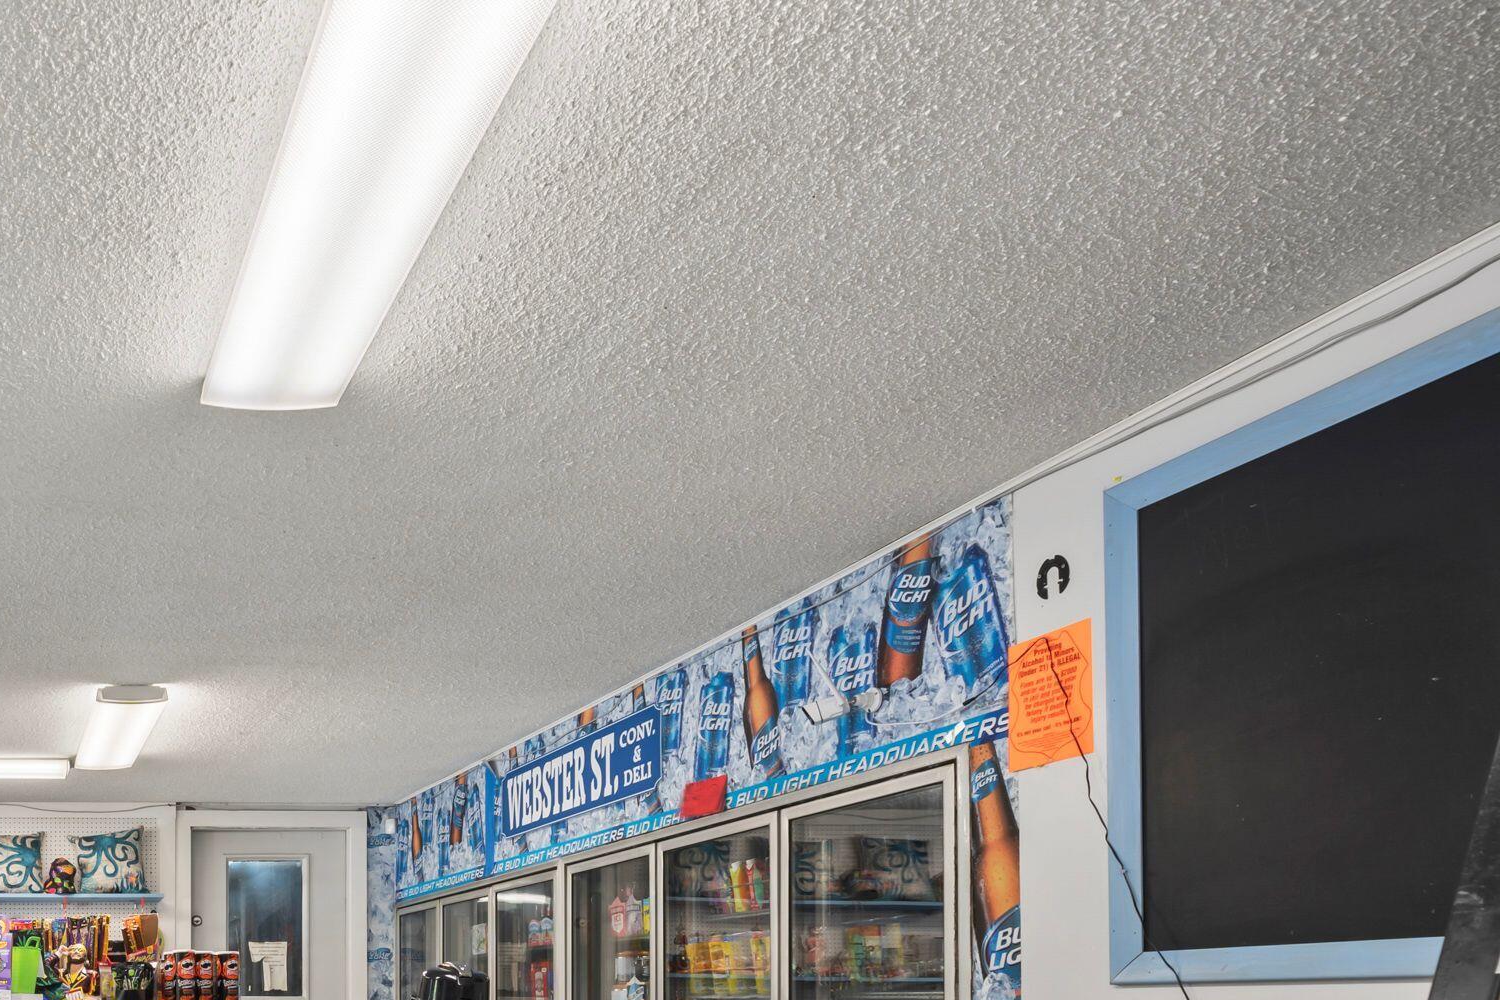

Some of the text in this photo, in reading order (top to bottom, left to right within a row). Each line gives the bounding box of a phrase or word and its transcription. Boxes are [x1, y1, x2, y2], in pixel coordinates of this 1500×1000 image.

[899, 574, 930, 589] BUD
[889, 588, 931, 604] LIGHT
[943, 580, 987, 625] BUD
[942, 593, 994, 647] LIGHT
[780, 626, 810, 645] BUD
[774, 644, 811, 664] LIGHT
[835, 653, 872, 677] BUD
[659, 688, 682, 702] BUD
[662, 701, 682, 715] GHT
[704, 701, 730, 716] BUD
[619, 719, 656, 749] CONV.
[701, 718, 730, 731] LIGHT
[757, 726, 780, 747] BUD
[632, 745, 641, 763] &
[754, 738, 781, 764] LIGHT
[507, 732, 620, 831] WEBSTER ST.
[623, 762, 652, 787] DELI
[973, 774, 998, 792] LIGHT
[976, 767, 996, 782] BUD
[737, 786, 769, 806] BUD
[772, 768, 826, 797] LIGHT
[505, 857, 520, 870] BUD
[522, 850, 544, 867] LIGHT
[545, 827, 624, 862] HEADQUARTERS
[626, 820, 651, 840] BUD
[653, 809, 686, 832] LIGH
[435, 868, 484, 888] HEADQUARTERS
